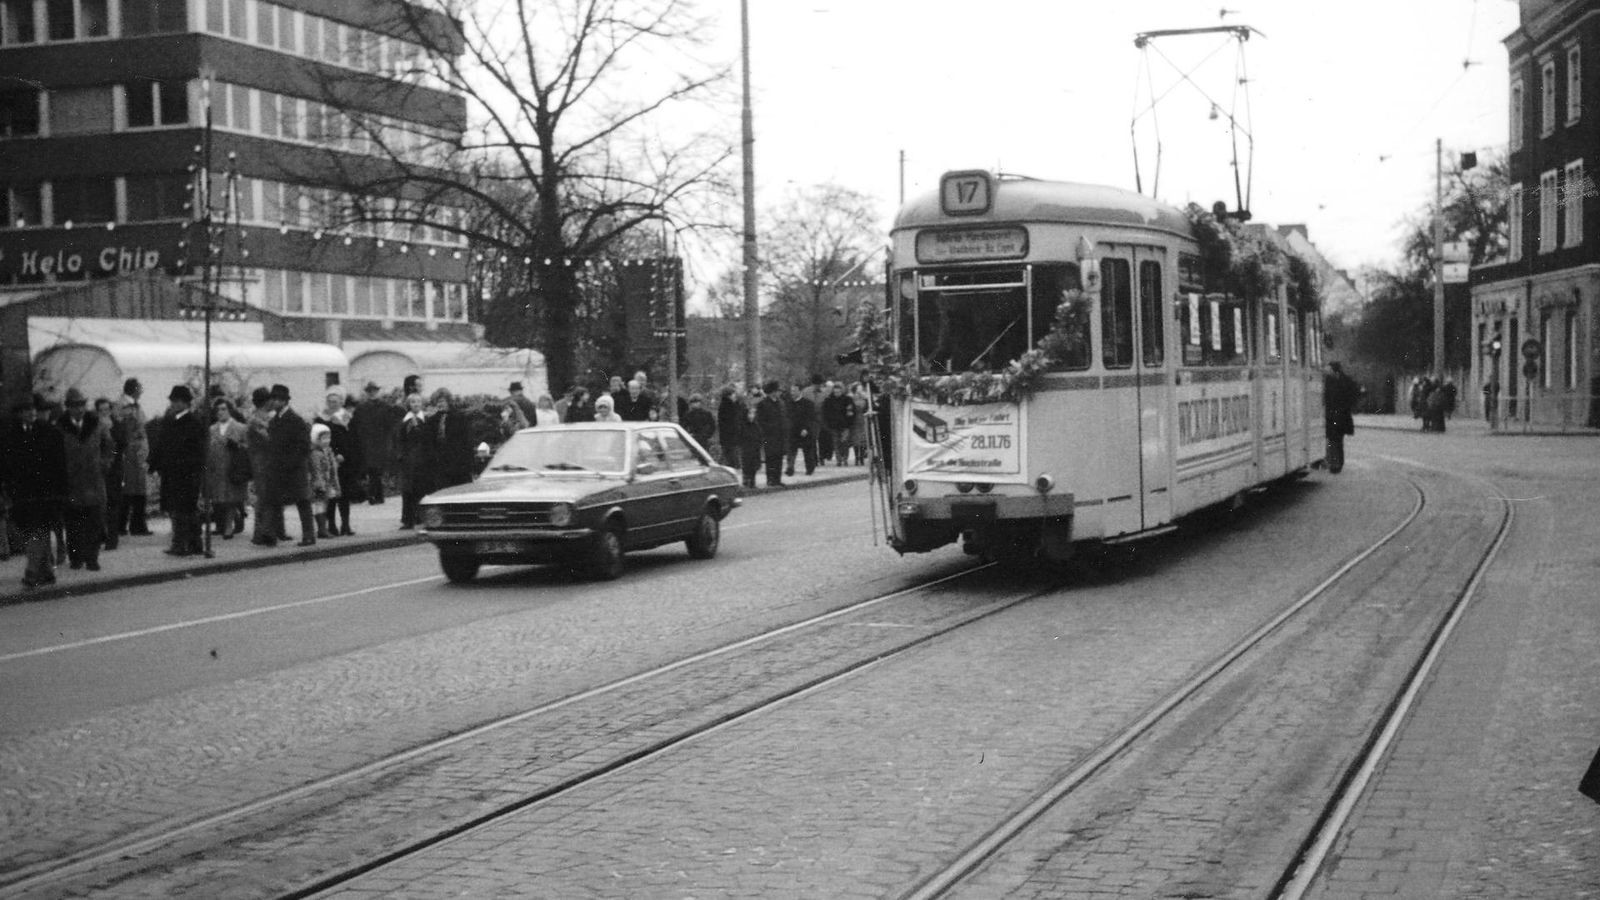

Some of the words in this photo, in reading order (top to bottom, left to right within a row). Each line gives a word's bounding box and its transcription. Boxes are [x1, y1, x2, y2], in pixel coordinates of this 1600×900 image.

[957, 181, 979, 204] 17
[100, 246, 160, 276] Chip
[971, 434, 1012, 449] 28.11.76
